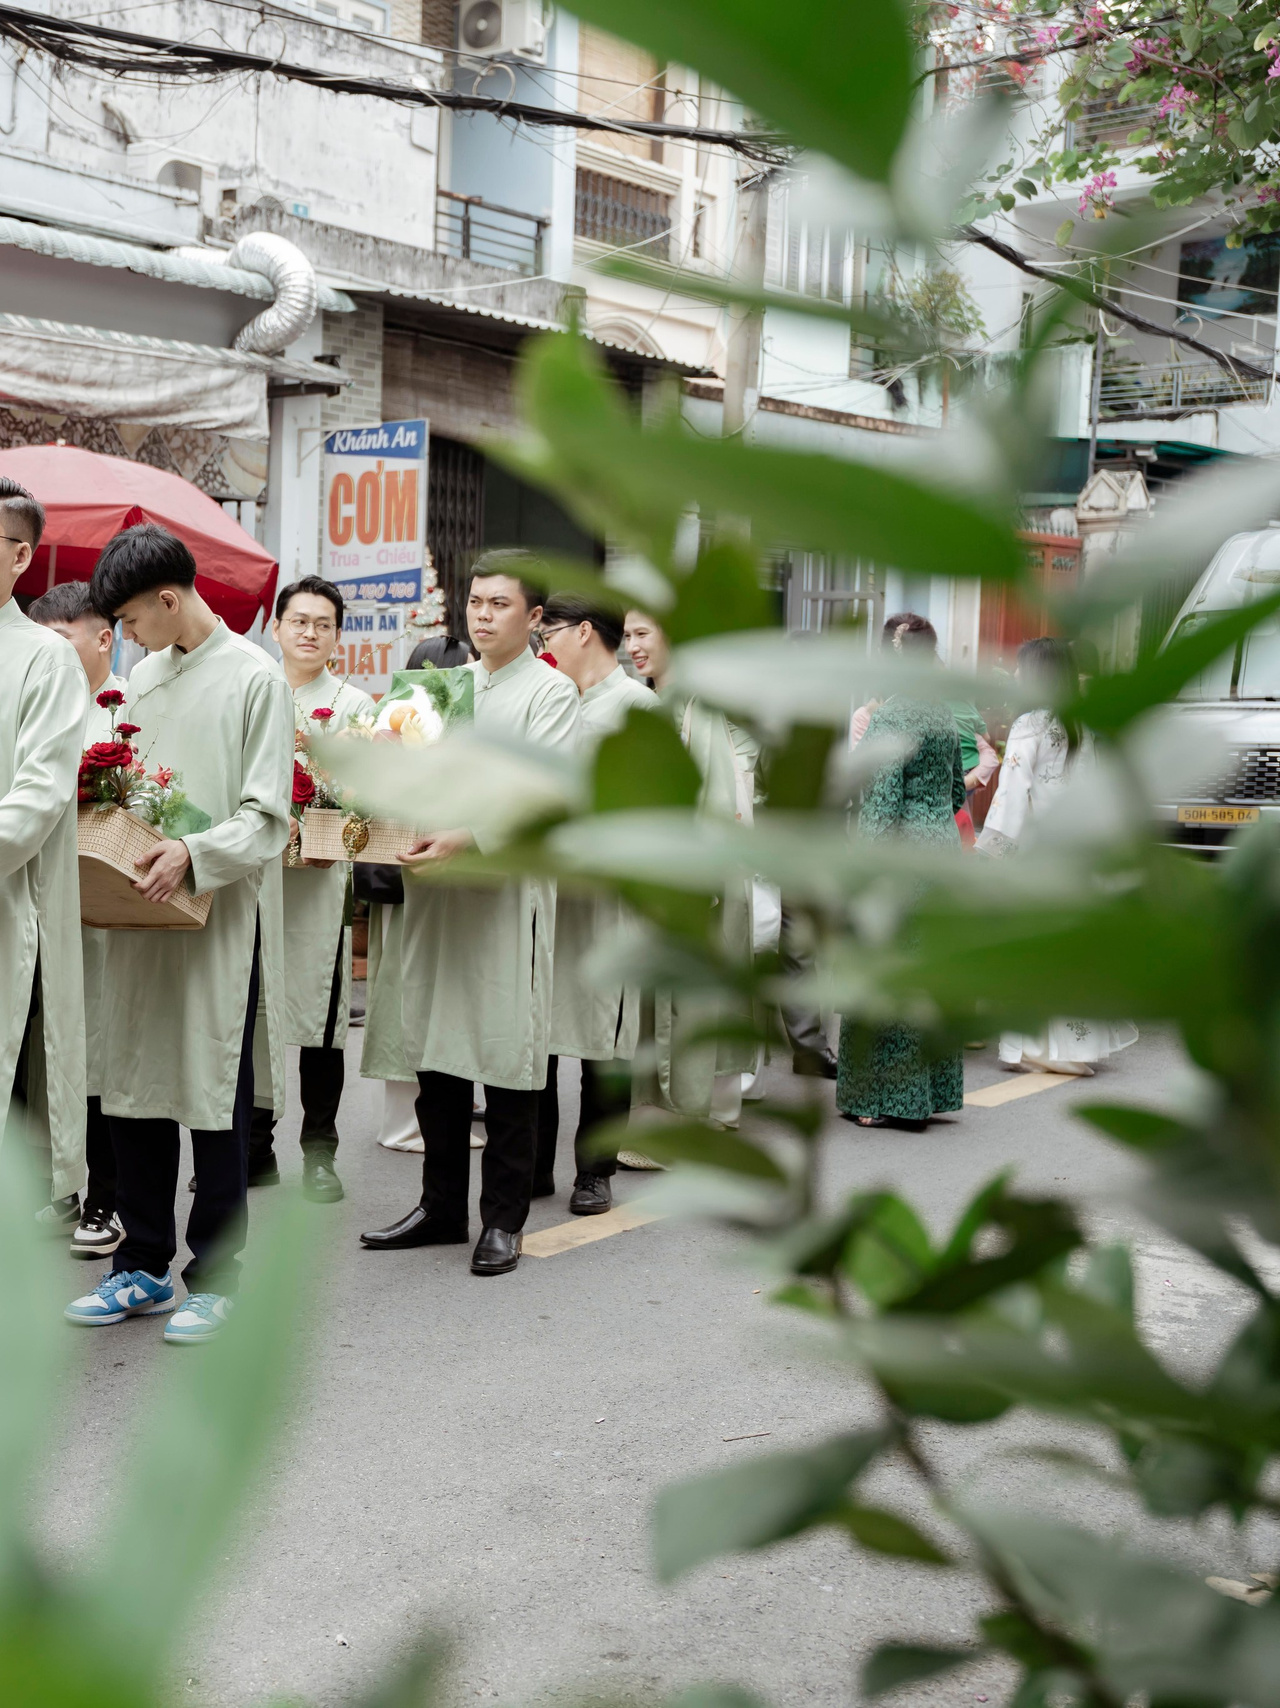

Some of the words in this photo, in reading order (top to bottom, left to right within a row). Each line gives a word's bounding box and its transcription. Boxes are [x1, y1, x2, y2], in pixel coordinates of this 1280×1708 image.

[333, 428, 389, 453] Khánh
[391, 425, 418, 448] An
[328, 460, 419, 547] CƠM
[358, 583, 386, 599] 490
[342, 612, 374, 631] ÁNH
[378, 615, 397, 630] AN
[333, 638, 393, 681] GIẶT
